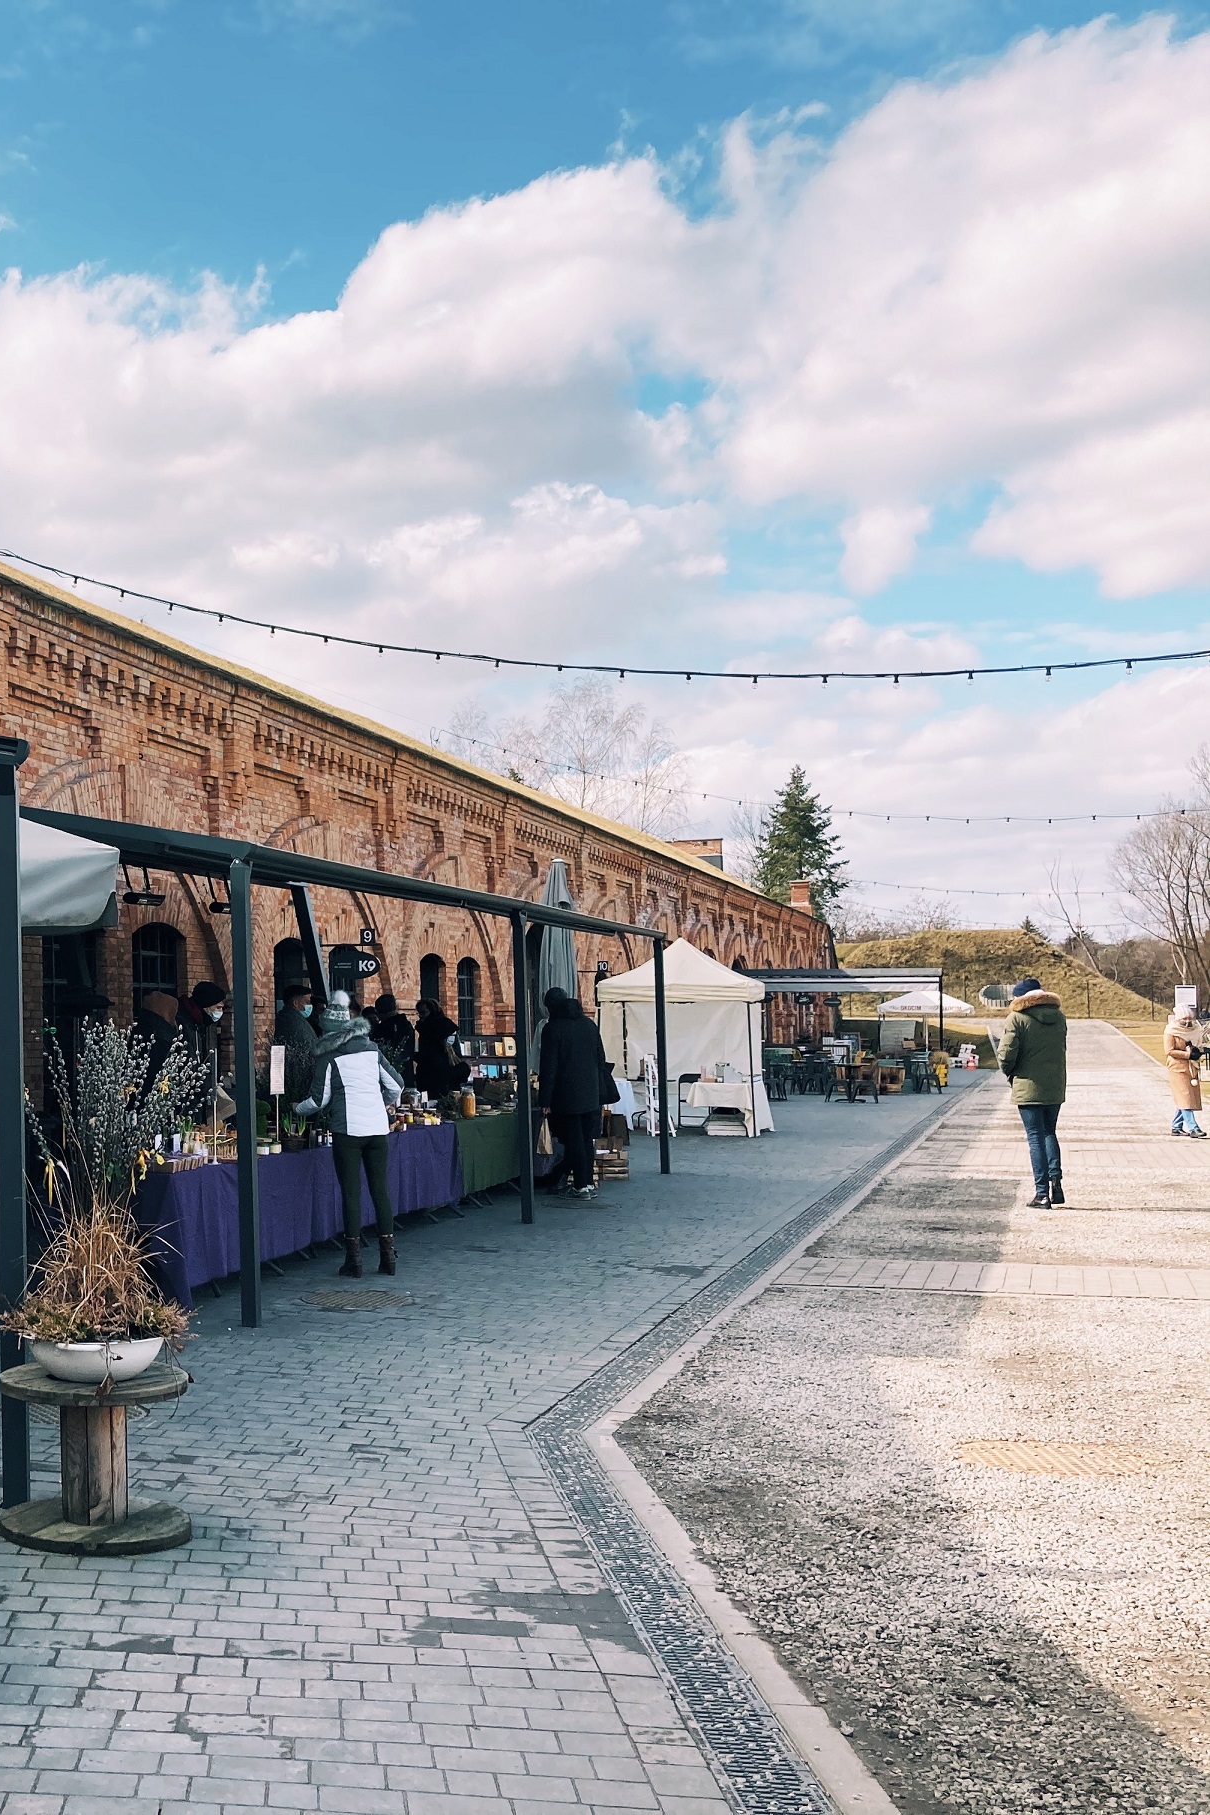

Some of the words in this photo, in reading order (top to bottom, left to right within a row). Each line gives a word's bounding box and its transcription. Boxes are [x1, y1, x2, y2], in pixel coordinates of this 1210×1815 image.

[363, 930, 372, 942] 9
[359, 960, 376, 971] K9
[598, 961, 608, 970] 10
